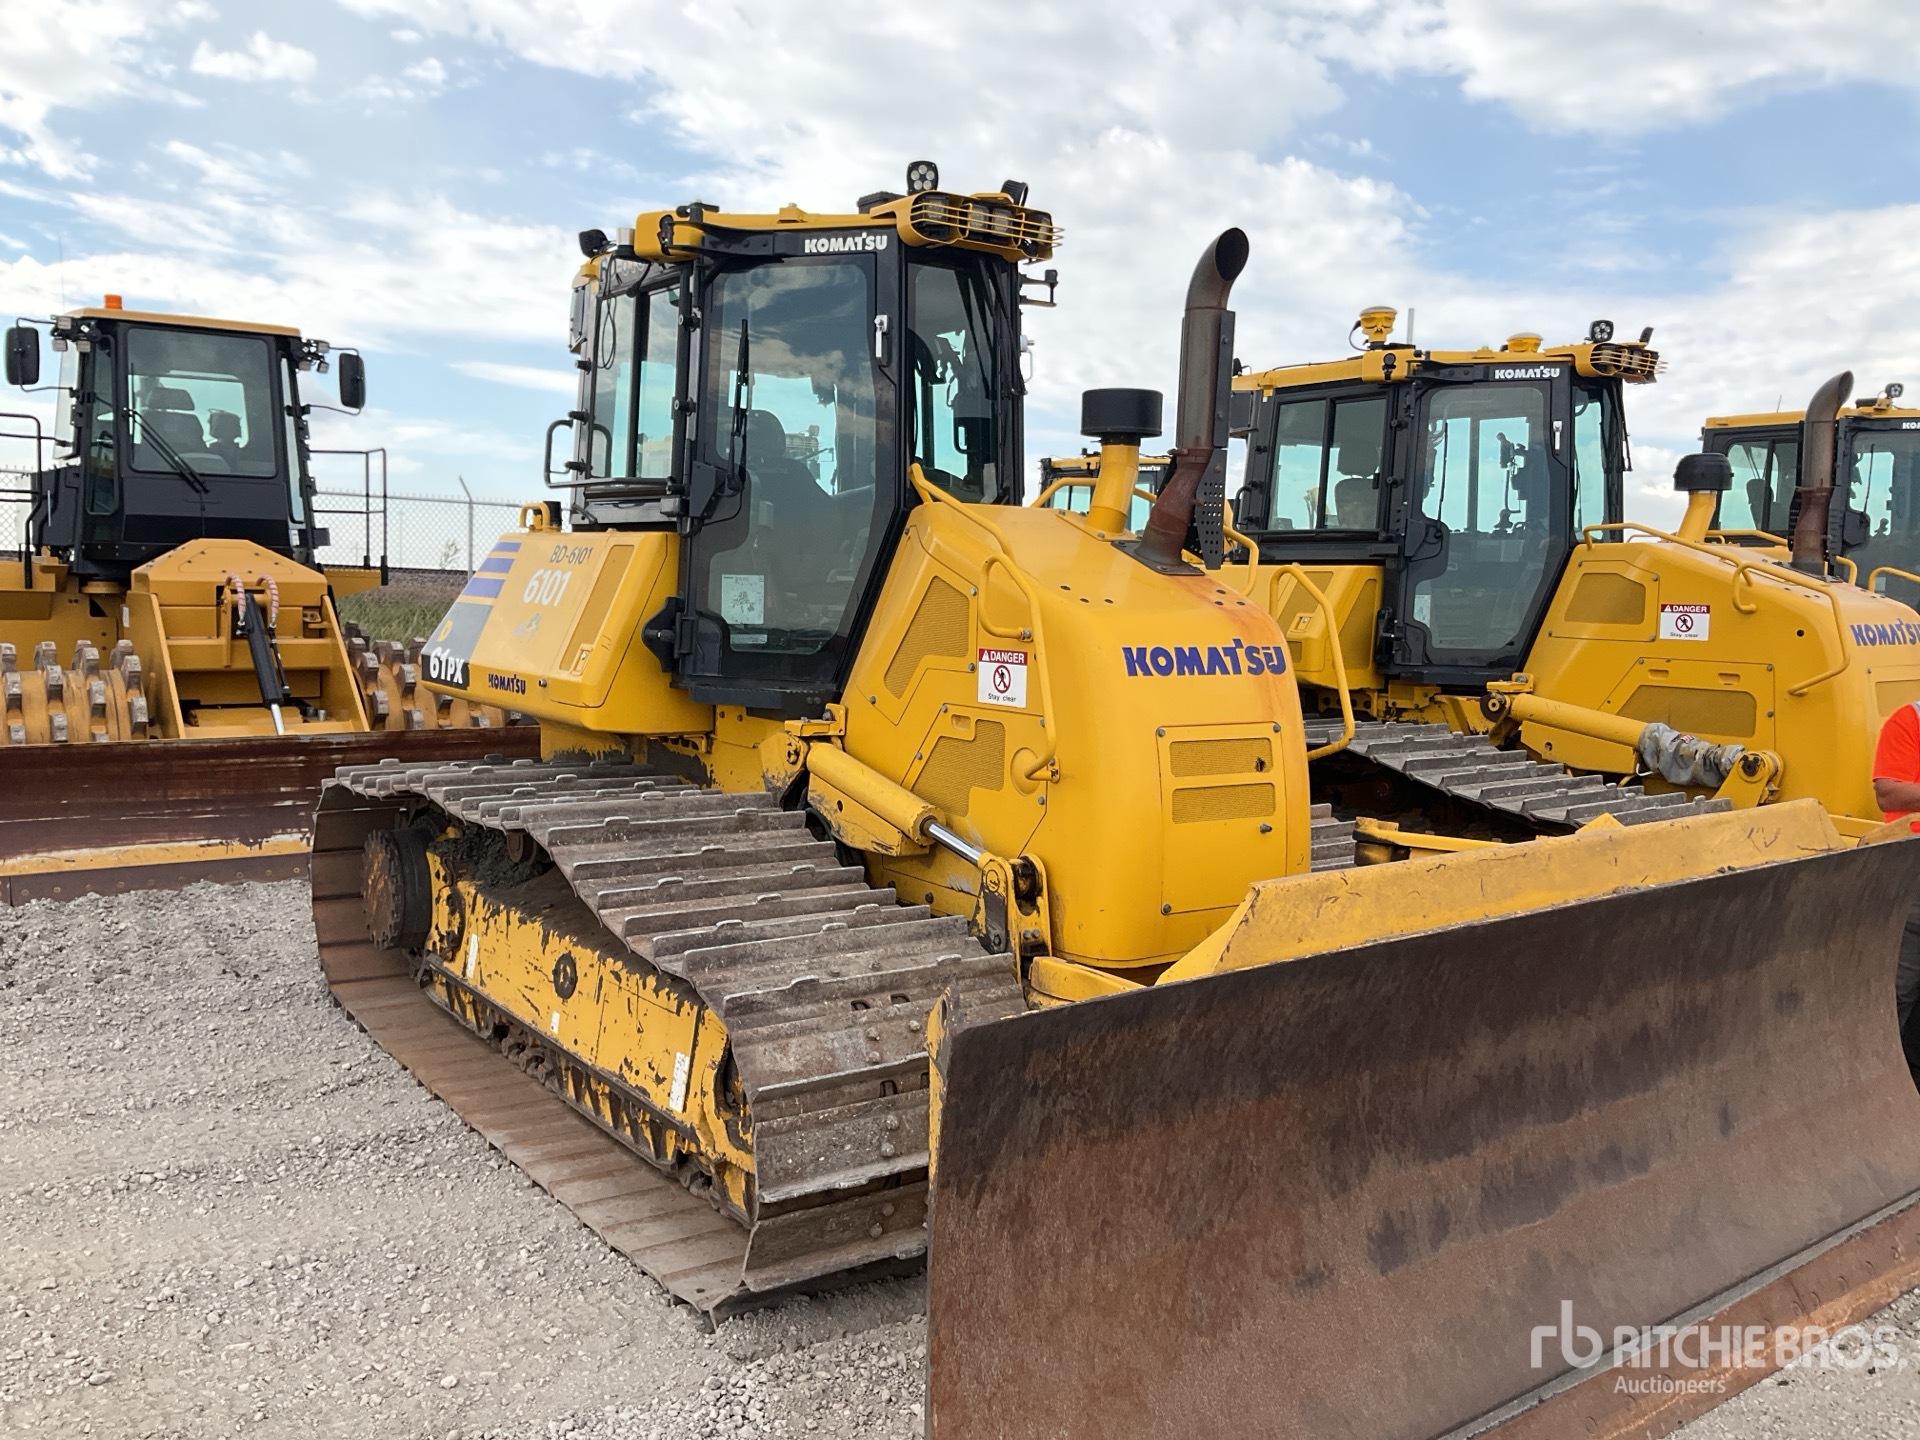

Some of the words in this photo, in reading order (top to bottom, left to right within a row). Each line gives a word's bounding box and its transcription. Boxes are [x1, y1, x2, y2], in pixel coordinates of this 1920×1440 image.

[804, 232, 888, 253] KOMATSU
[1494, 366, 1560, 379] KOMATSU
[550, 545, 593, 565] BD-6101
[523, 568, 572, 607] 6101
[1672, 605, 1707, 613] DANGER
[429, 646, 465, 685] 61PX
[990, 650, 1025, 664] DANGER
[1122, 638, 1287, 677] KOMATSU
[488, 673, 527, 695] KOMATSU
[988, 692, 1000, 702] Stay
[1002, 694, 1017, 702] clear
